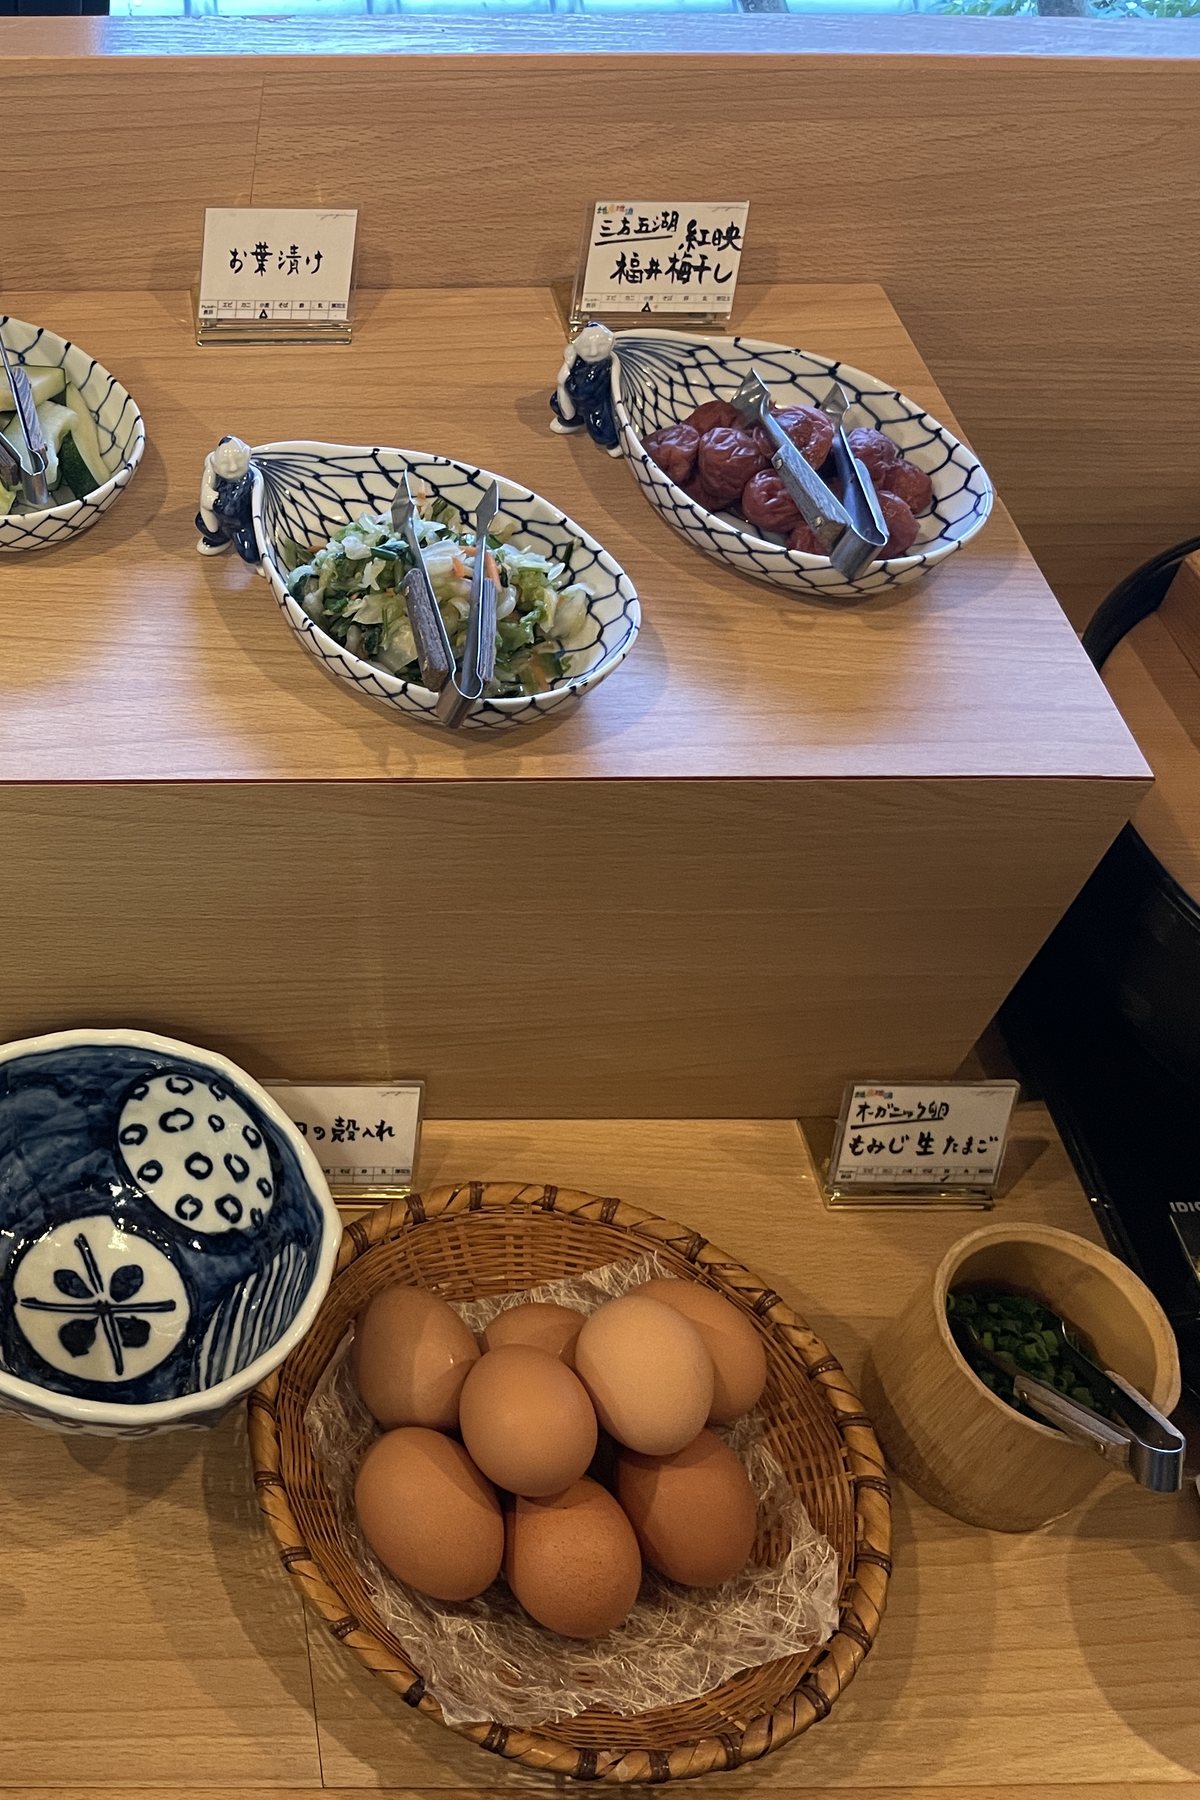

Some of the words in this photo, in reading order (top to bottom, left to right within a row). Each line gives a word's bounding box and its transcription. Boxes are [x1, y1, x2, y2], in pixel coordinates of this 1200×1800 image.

[600, 211, 679, 237] 三方五湖
[678, 219, 742, 252] 紅映
[229, 241, 323, 277] お葉漬け
[610, 252, 733, 284] 福井梅干し
[856, 1101, 950, 1122] オーガニック卵
